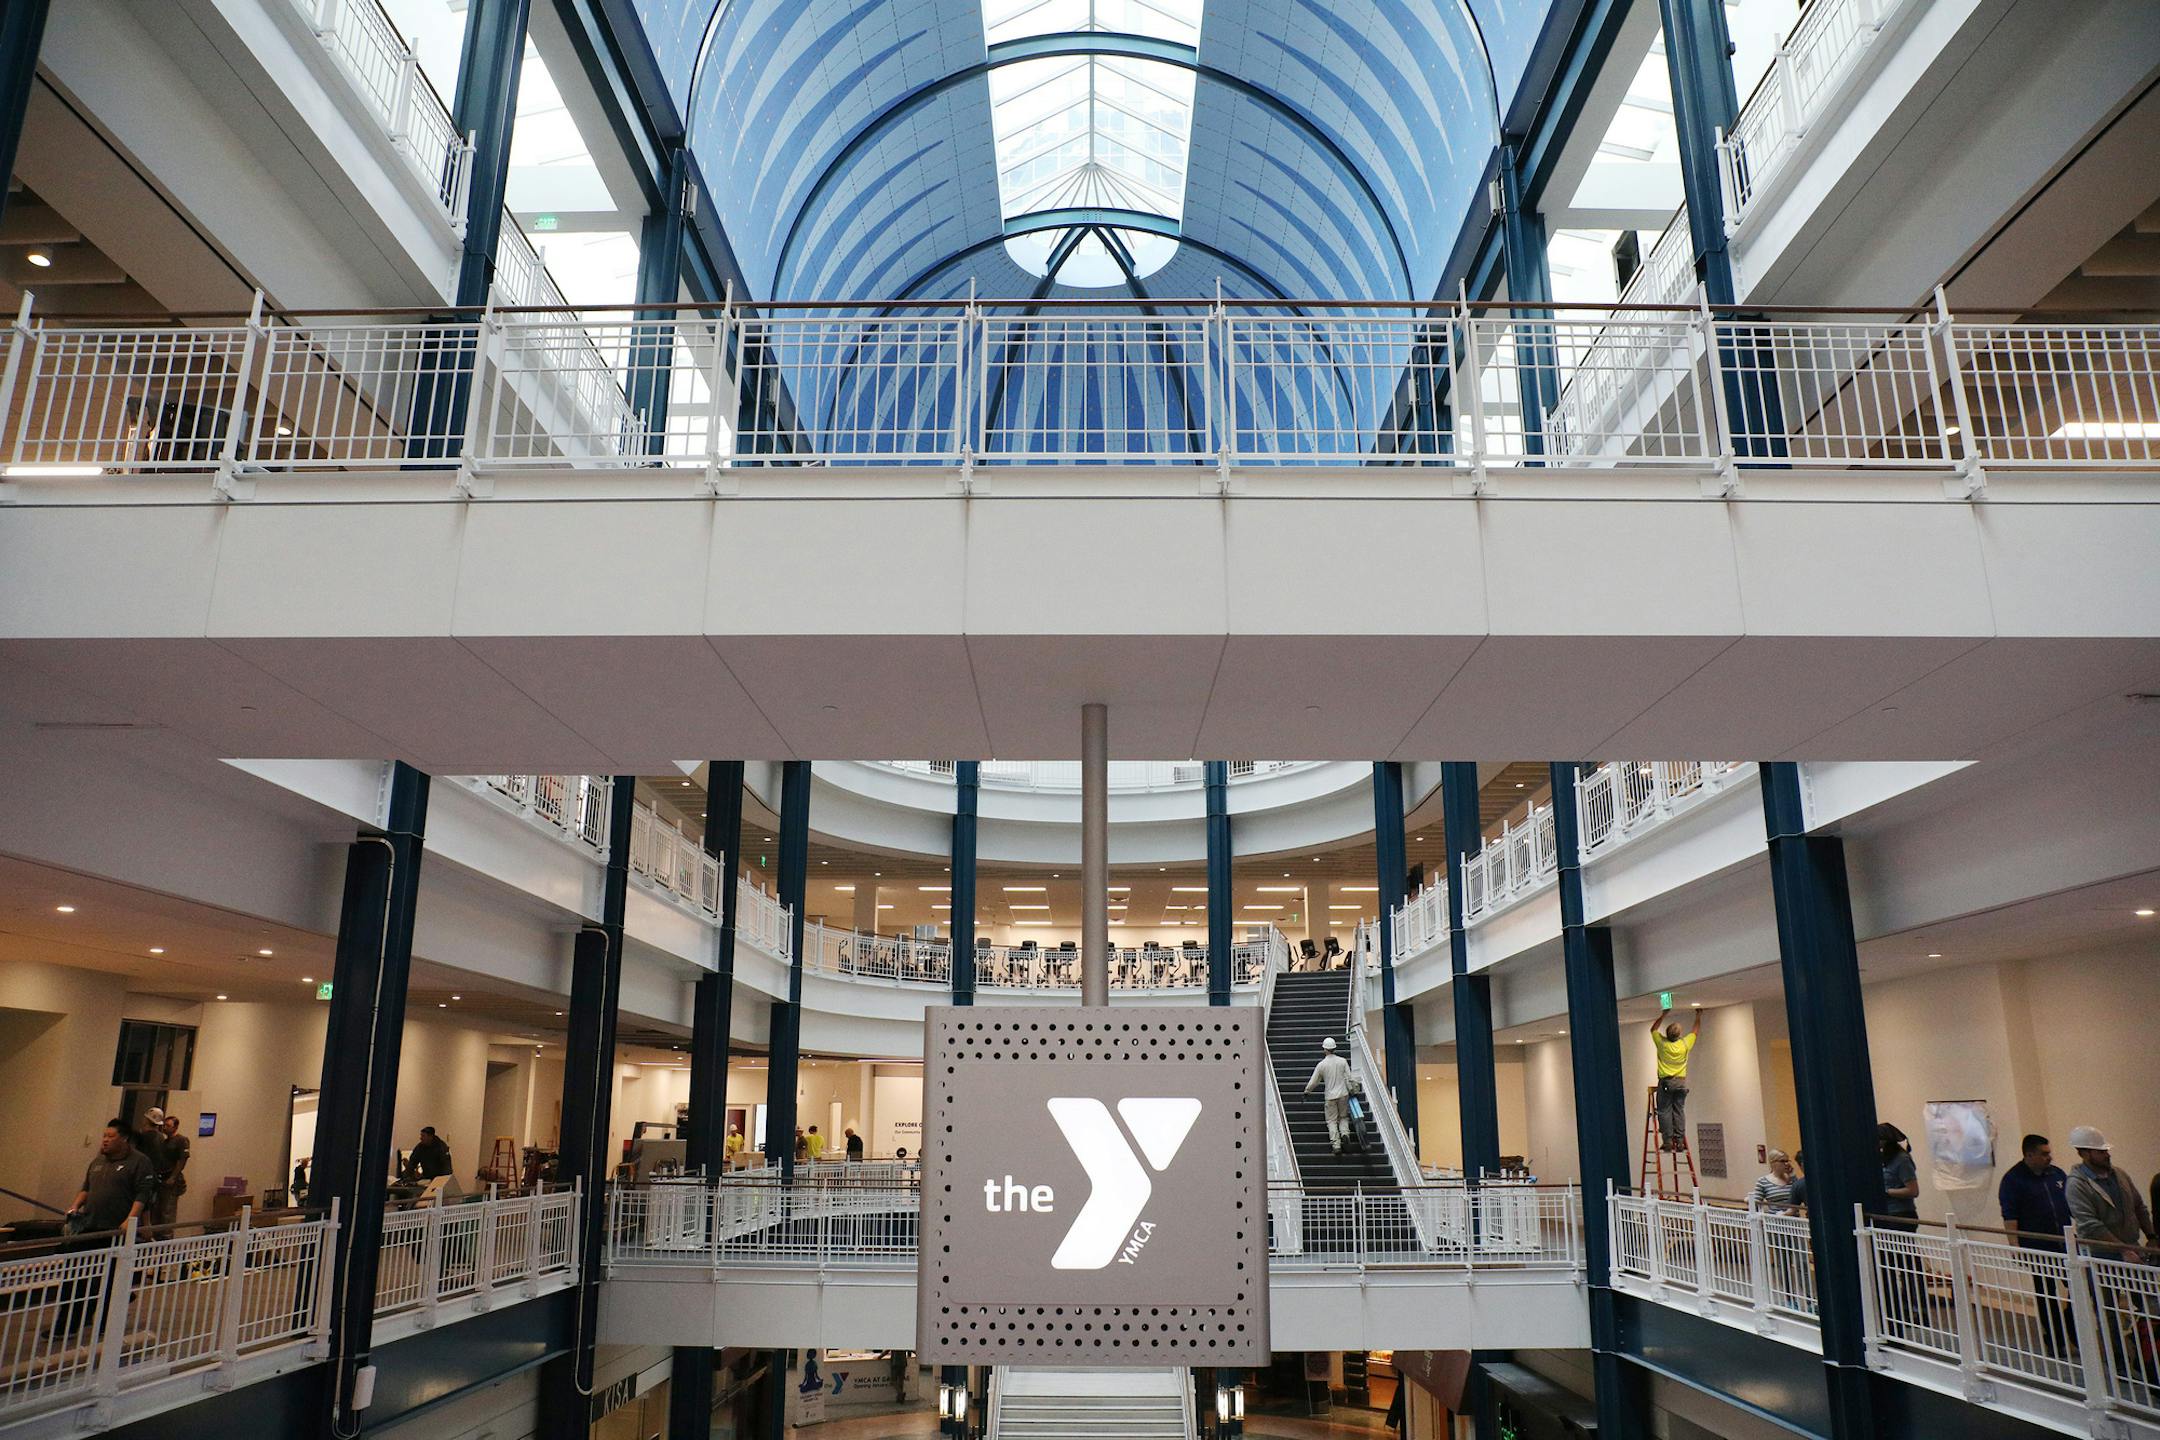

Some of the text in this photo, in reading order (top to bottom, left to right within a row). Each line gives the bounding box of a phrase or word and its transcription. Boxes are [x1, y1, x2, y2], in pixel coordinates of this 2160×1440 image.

[983, 1174, 1054, 1212] the
[1117, 1219, 1156, 1265] YMCA
[603, 1377, 629, 1416] KISA
[854, 1376, 871, 1384] YMCA
